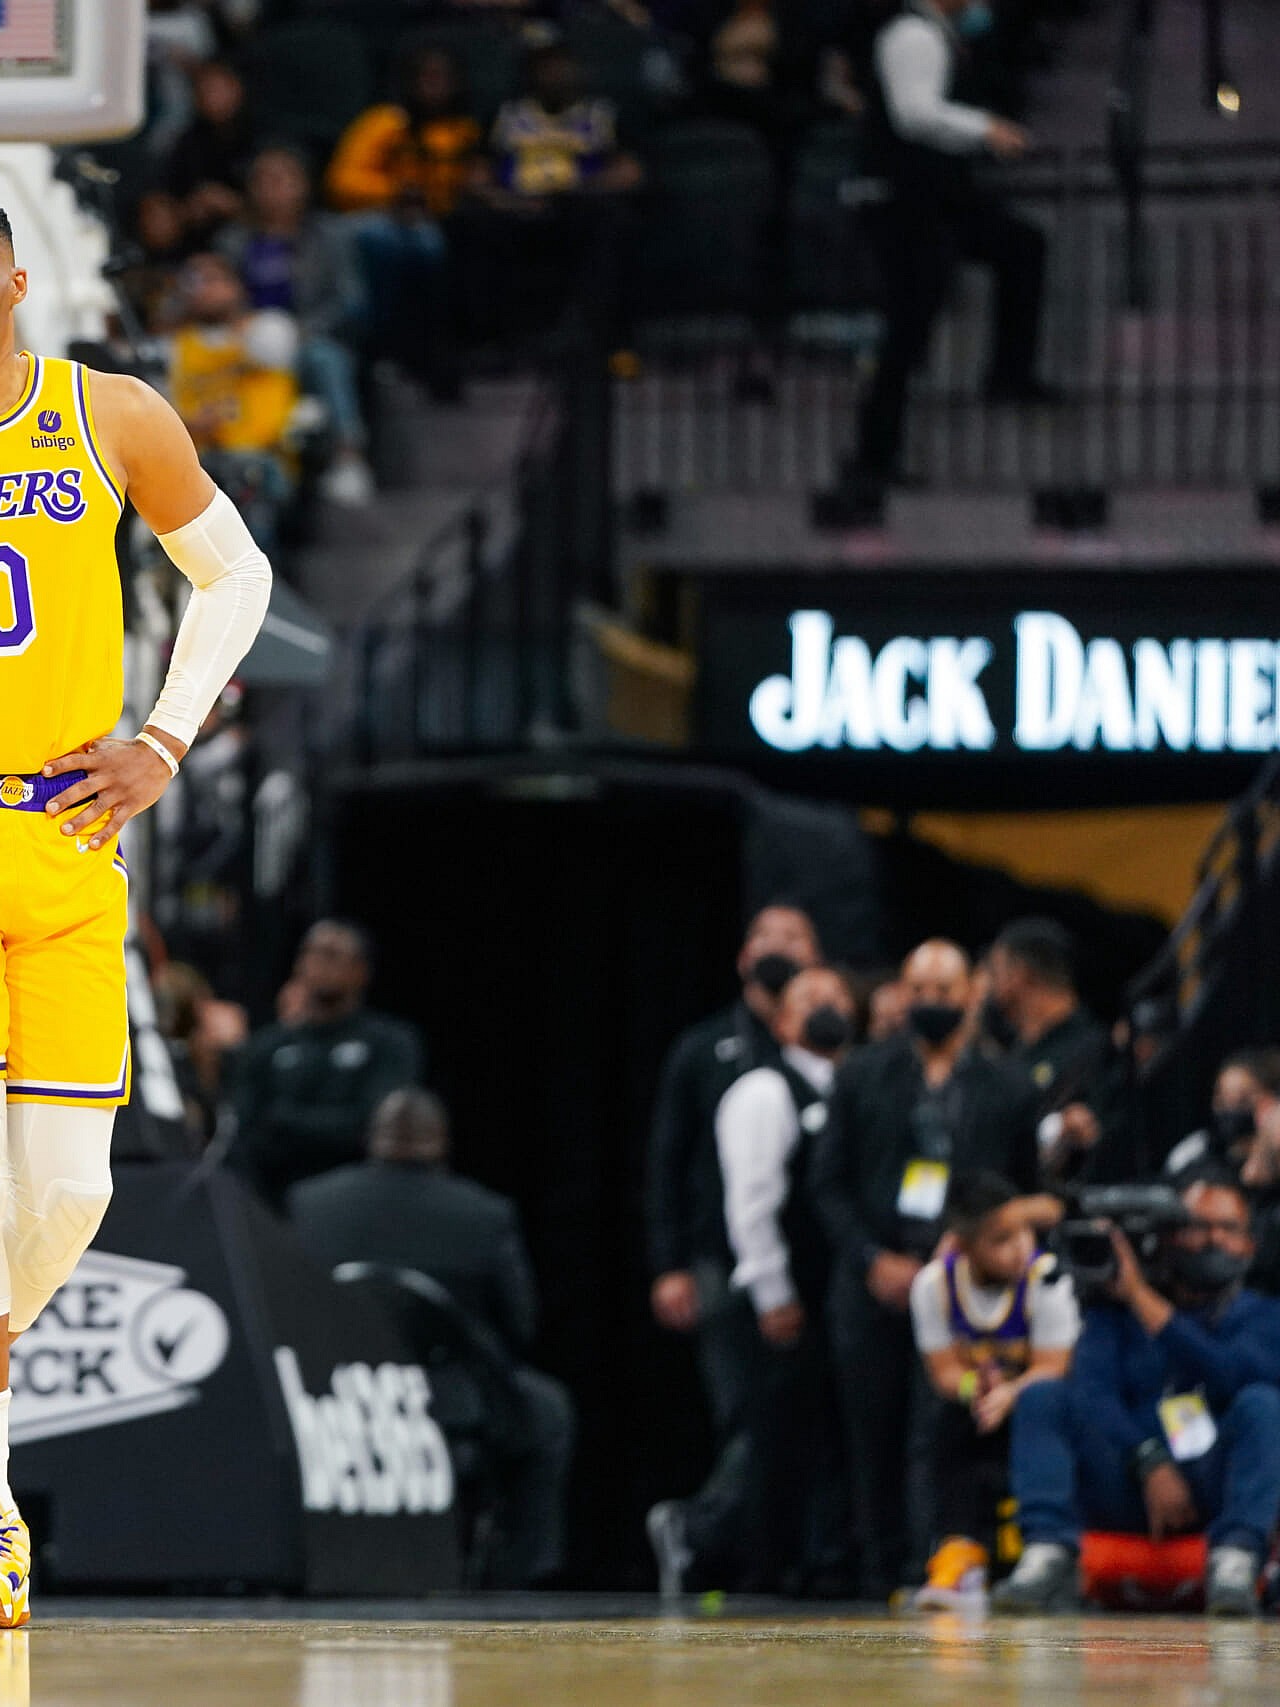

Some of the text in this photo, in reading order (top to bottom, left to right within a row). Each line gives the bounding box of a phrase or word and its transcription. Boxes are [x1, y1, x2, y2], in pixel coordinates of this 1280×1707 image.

[31, 435, 76, 451] bibigo
[749, 608, 1280, 752] JACK DANIE
